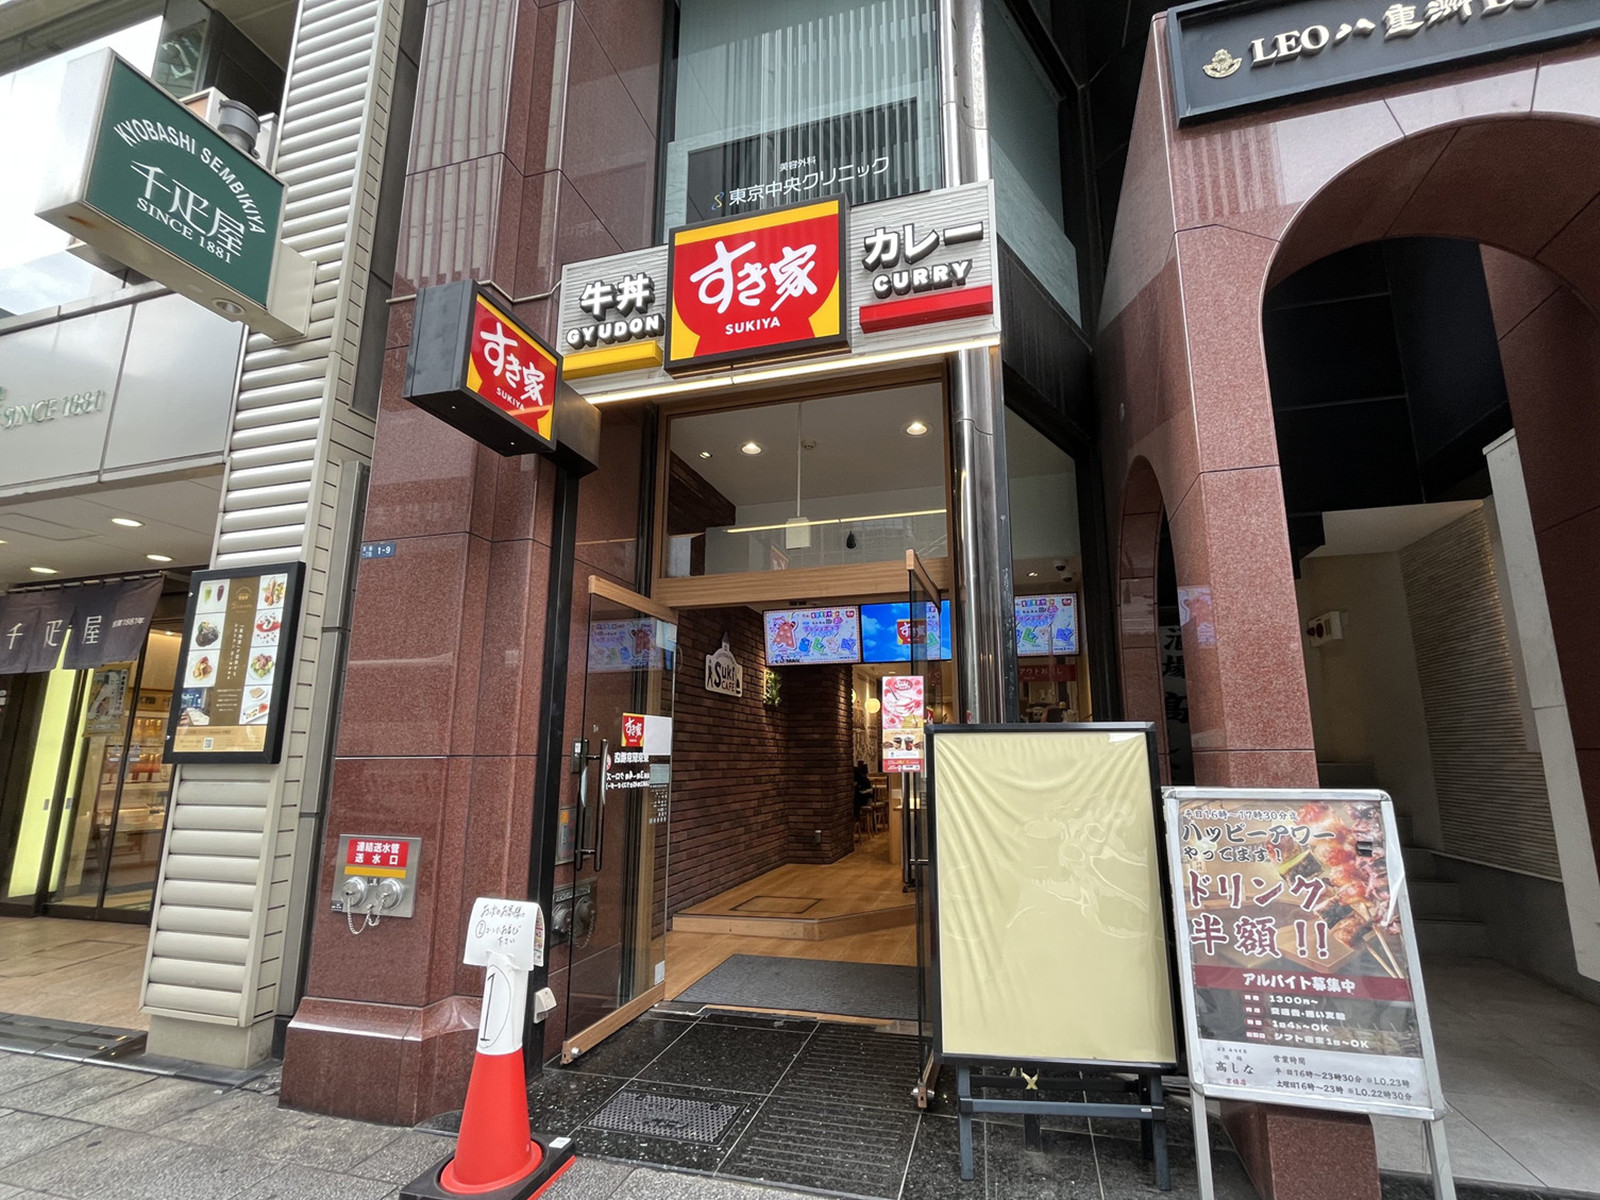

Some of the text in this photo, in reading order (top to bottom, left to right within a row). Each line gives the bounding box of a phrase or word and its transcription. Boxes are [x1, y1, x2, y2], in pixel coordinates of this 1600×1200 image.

[113, 117, 267, 235] KYOBASHI SEMBIKIYA
[728, 156, 890, 207] 東京中央クリニック
[779, 155, 817, 172] 美容外科
[130, 159, 246, 257] 千疋屋
[136, 197, 232, 265] SINCE 1881
[863, 221, 985, 272] カレー
[579, 272, 655, 320] 牛丼
[689, 239, 818, 314] すき家
[873, 259, 973, 298] CURRY
[566, 314, 662, 348] GYUDON
[724, 317, 781, 335] SUKIYA
[480, 321, 546, 407] すき家
[2, 389, 106, 429] SINCE 1881
[496, 387, 525, 411] SUKIYA
[377, 545, 391, 555] 1-9
[6, 615, 102, 650] 千疋屋
[1182, 822, 1336, 845] ハッピーアワー
[1183, 846, 1282, 863] やってます！
[1188, 870, 1325, 912] ドリンク
[1242, 972, 1356, 994] アルバイト募集中
[1273, 1055, 1306, 1065] 営業時間
